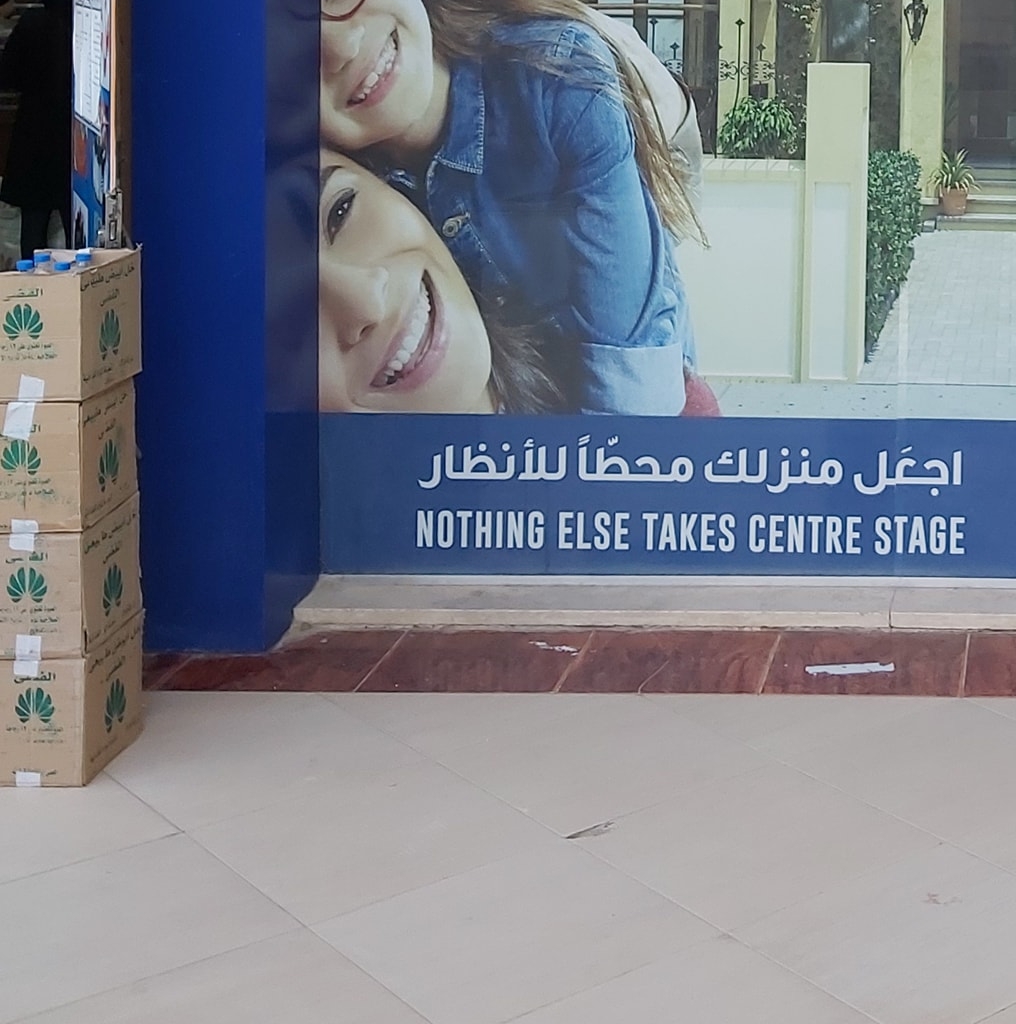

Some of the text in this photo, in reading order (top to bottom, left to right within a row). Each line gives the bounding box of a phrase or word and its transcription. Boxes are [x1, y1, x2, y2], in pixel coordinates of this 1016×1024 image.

[417, 436, 567, 489] للأنظار
[704, 447, 845, 494] منزلك
[416, 510, 966, 555] NOTHING ELSE TAKES CENTRE STAGE
